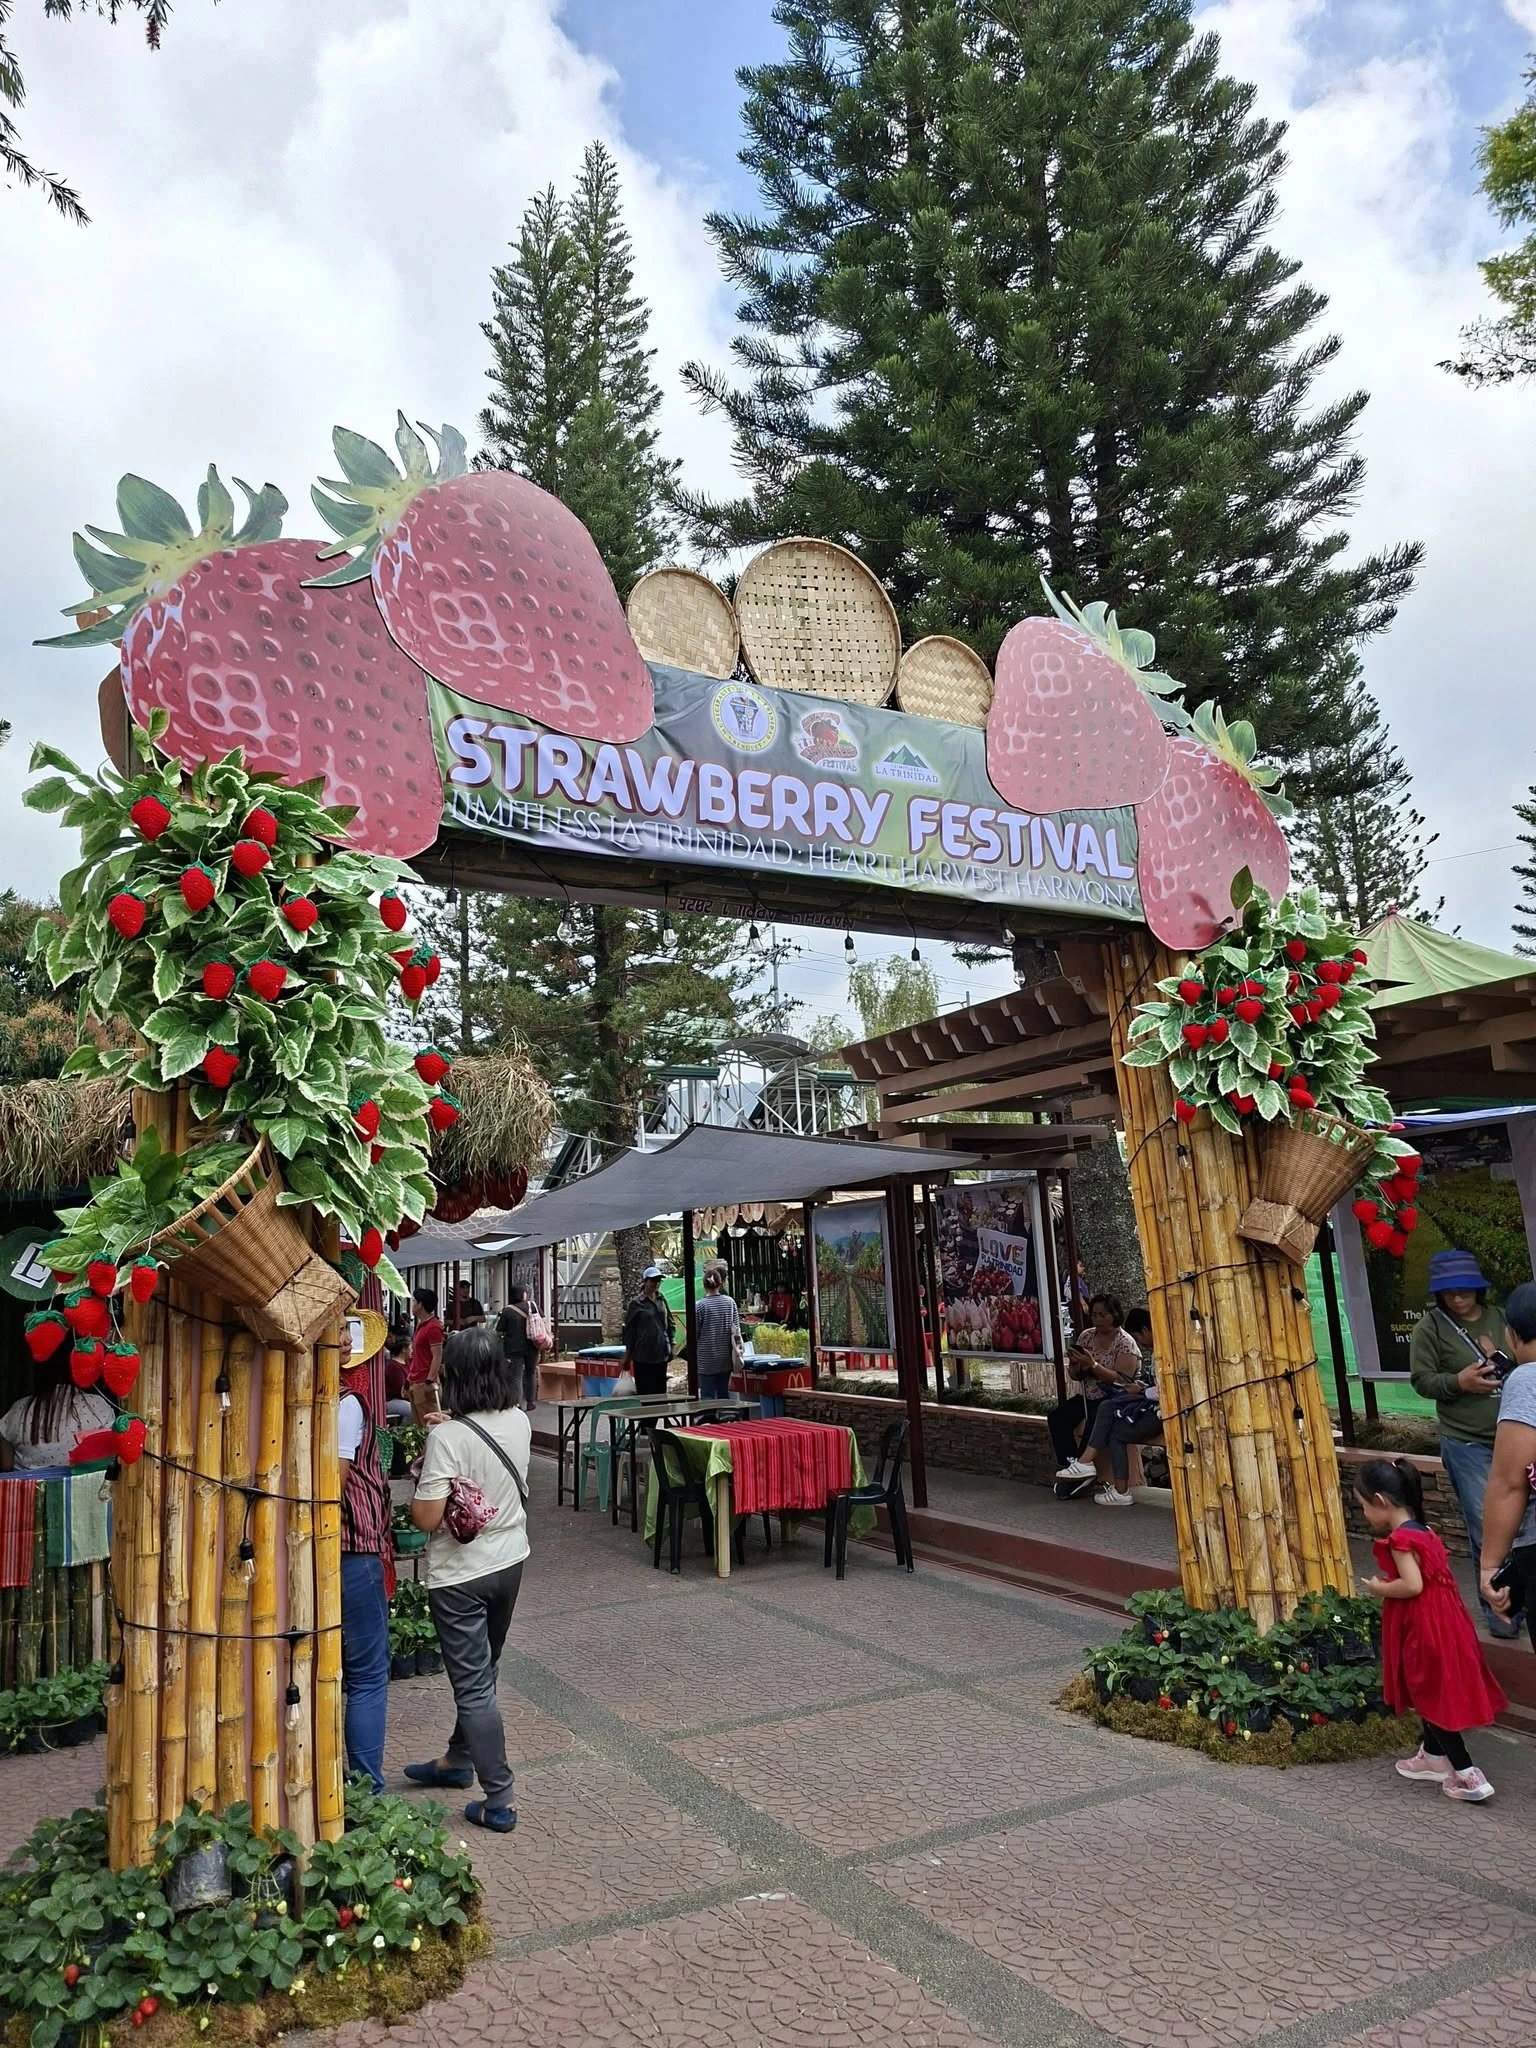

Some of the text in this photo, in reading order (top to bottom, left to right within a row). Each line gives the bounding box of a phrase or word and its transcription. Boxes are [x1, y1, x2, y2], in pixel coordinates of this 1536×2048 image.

[822, 759, 858, 772] FESTIVAL
[875, 766, 939, 783] LA TRINIDAD
[446, 716, 1135, 880] STRAWBERRY FESTIVAL
[450, 788, 601, 839] LIMITLESS
[608, 815, 643, 851] LA
[1014, 869, 1137, 909] HARMONY
[980, 1237, 1024, 1266] LOVE
[1403, 1310, 1422, 1320] The
[1394, 1332, 1405, 1343] in
